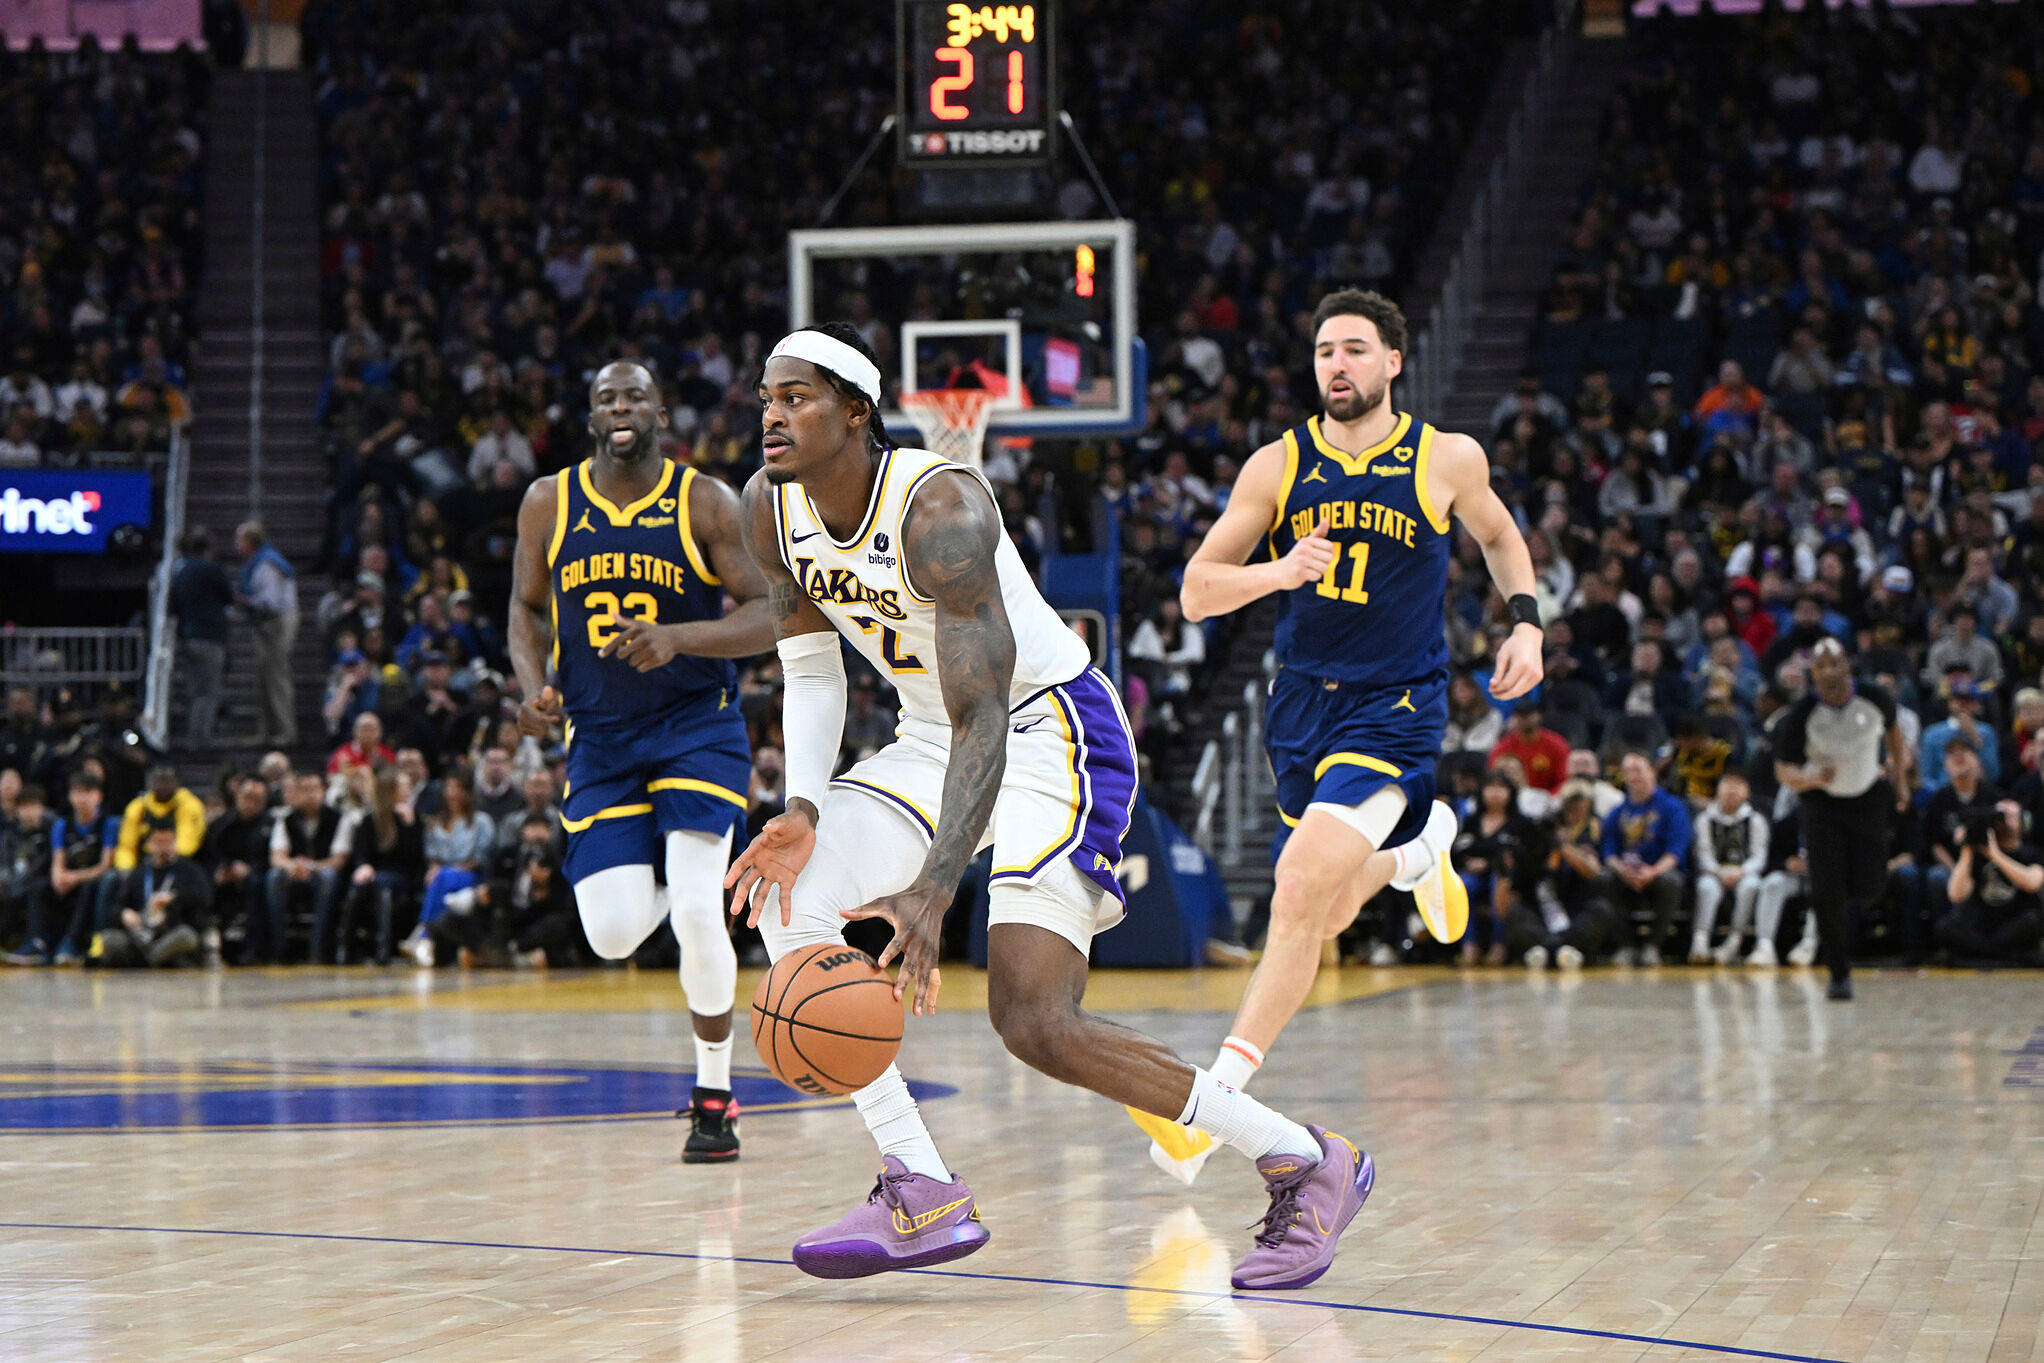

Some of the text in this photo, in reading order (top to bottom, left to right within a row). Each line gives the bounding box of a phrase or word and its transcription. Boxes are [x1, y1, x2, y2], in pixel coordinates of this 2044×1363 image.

[946, 3, 1035, 47] 3:44
[948, 129, 1046, 154] TISSOT
[0, 487, 93, 535] inet
[1359, 501, 1418, 549] STATE
[561, 552, 685, 595] GOLDEN STATE
[868, 553, 896, 569] bibigo
[1316, 541, 1370, 604] 11
[847, 615, 928, 675] 2
